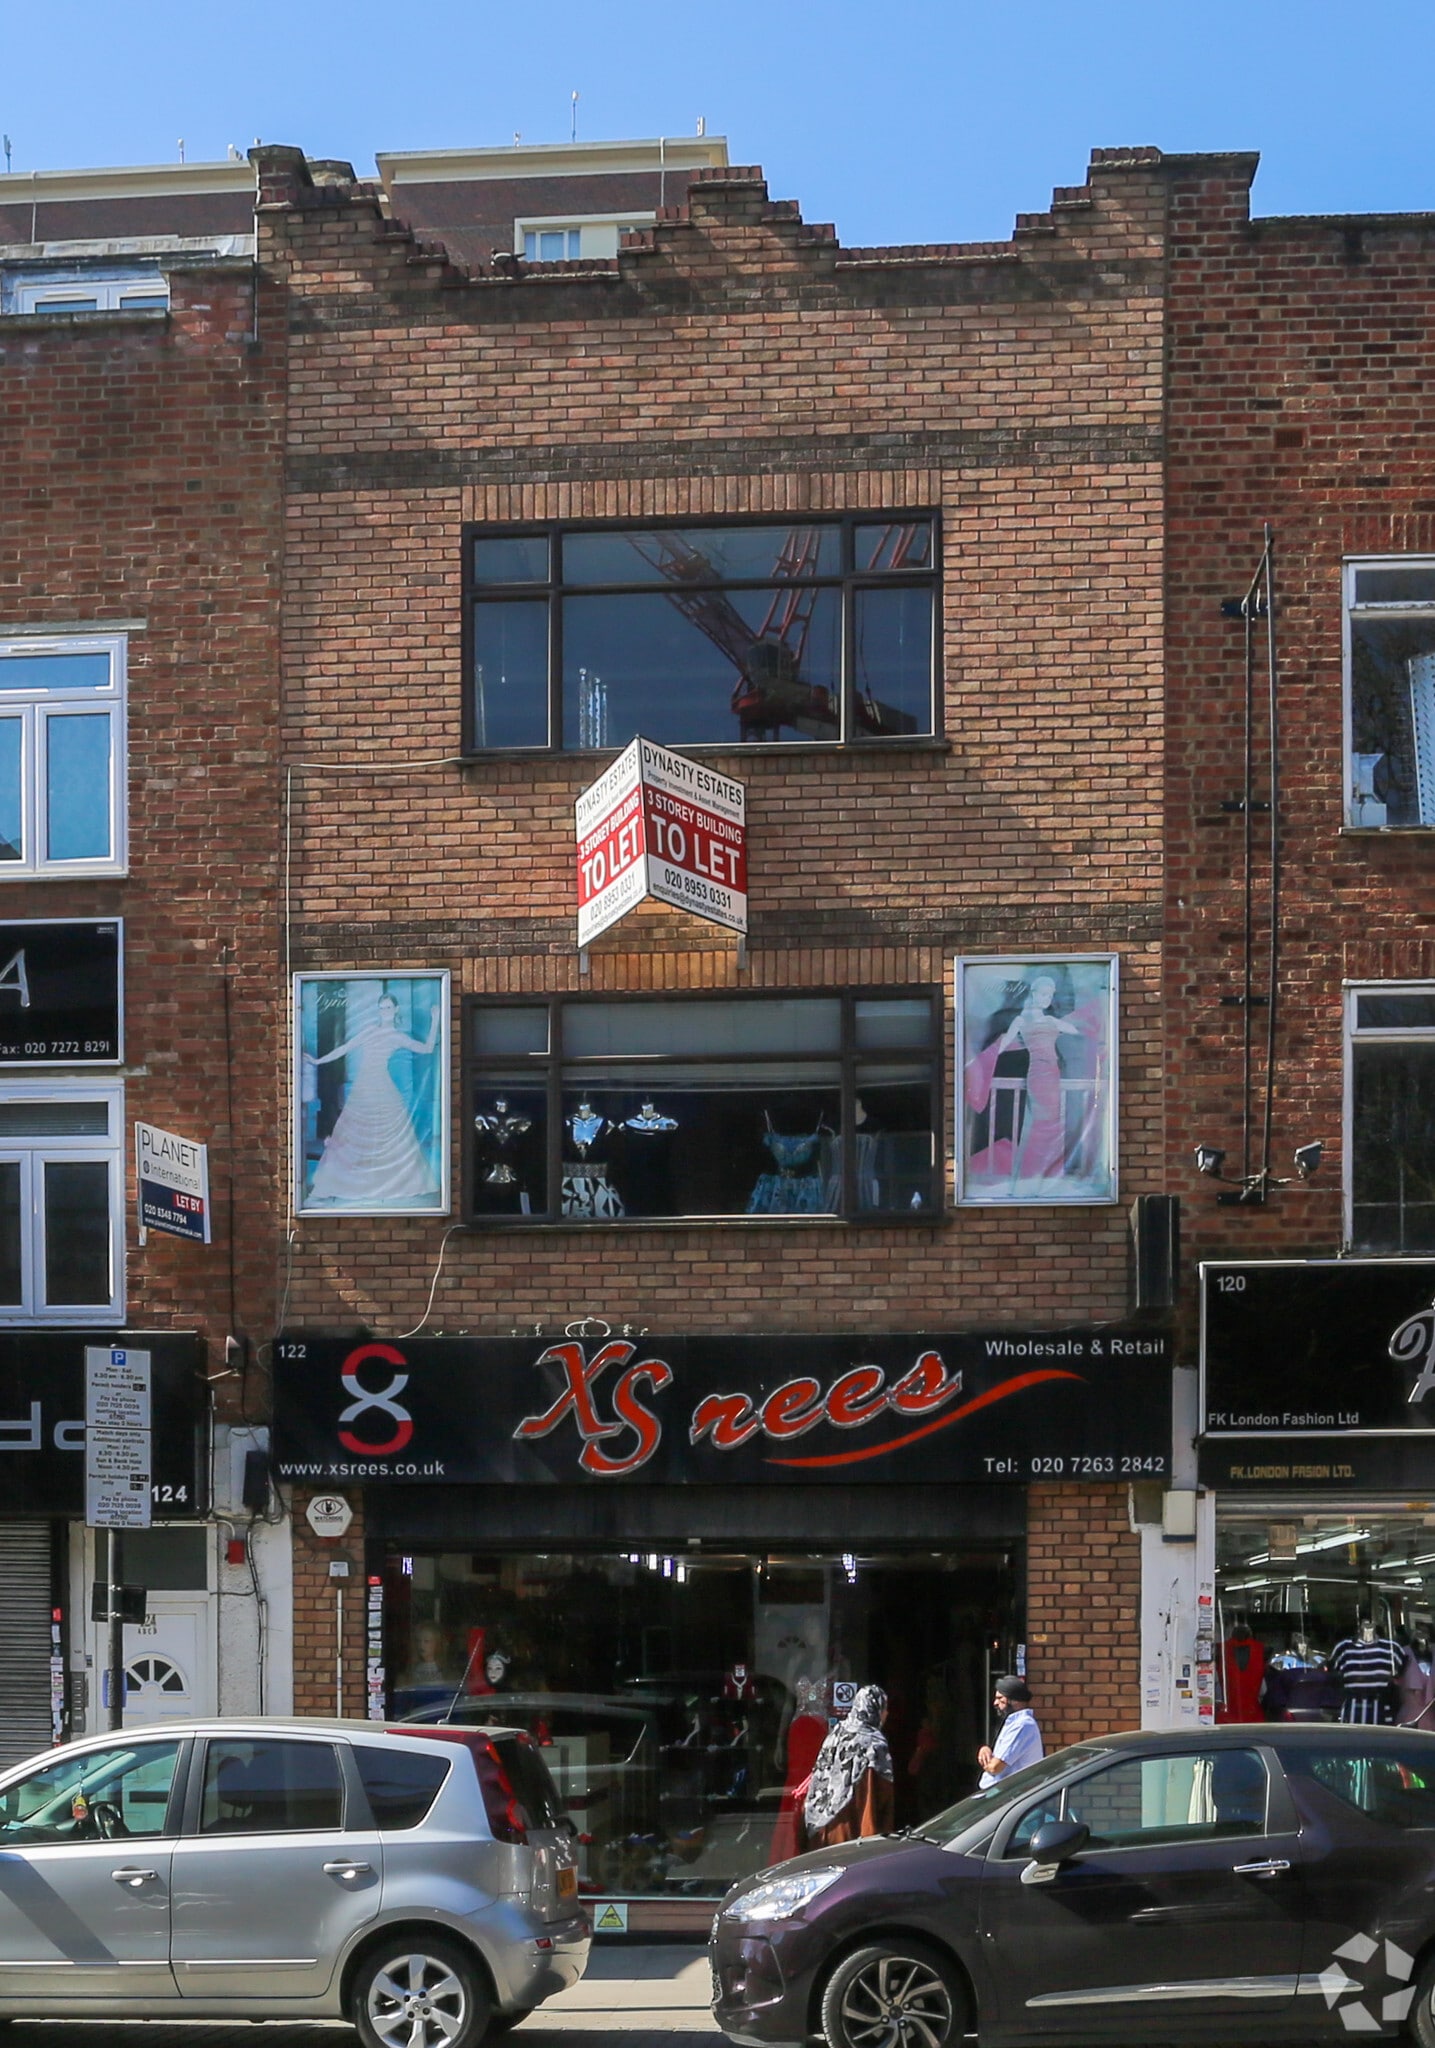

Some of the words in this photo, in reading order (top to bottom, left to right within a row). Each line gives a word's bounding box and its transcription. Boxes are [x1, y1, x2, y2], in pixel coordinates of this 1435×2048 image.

[578, 779, 608, 821] DYNASTY
[610, 748, 636, 790] ESTATES
[644, 746, 694, 783] DYNASTY
[697, 771, 742, 806] ESTATES
[585, 820, 610, 856] STOREY
[610, 790, 639, 832] BUILDING
[648, 790, 653, 805] 3
[656, 794, 694, 824] STOREY
[697, 812, 742, 844] BUILDING
[582, 850, 606, 898] TO
[609, 814, 638, 878] LET
[652, 814, 686, 862] TO
[694, 833, 740, 884] LET
[665, 868, 682, 888] 020
[684, 877, 707, 899] 8953
[710, 888, 731, 909] 0331
[25, 1043, 46, 1053] 020
[51, 1042, 79, 1053] 7272
[84, 1041, 109, 1052] 8291
[142, 1129, 198, 1168] PLANET
[144, 1204, 156, 1215] 020
[176, 1194, 188, 1208] LET
[191, 1198, 200, 1212] BY
[1217, 1276, 1246, 1292] 120
[280, 1344, 306, 1358] 122
[985, 1340, 1083, 1356] Wholesale
[1090, 1340, 1104, 1355] &
[1111, 1339, 1164, 1354] Retail
[1208, 1414, 1226, 1425] FK
[1230, 1413, 1279, 1425] London
[1283, 1412, 1334, 1424] Fashion
[1338, 1412, 1359, 1424] Ltd
[279, 1460, 446, 1475] www.xsrees.co.uk
[984, 1458, 1018, 1472] Tel:
[1031, 1458, 1064, 1472] 020
[1070, 1458, 1114, 1472] 7263
[1121, 1457, 1164, 1472] 2842
[1333, 1466, 1355, 1478] LTD.
[152, 1485, 187, 1502] 124
